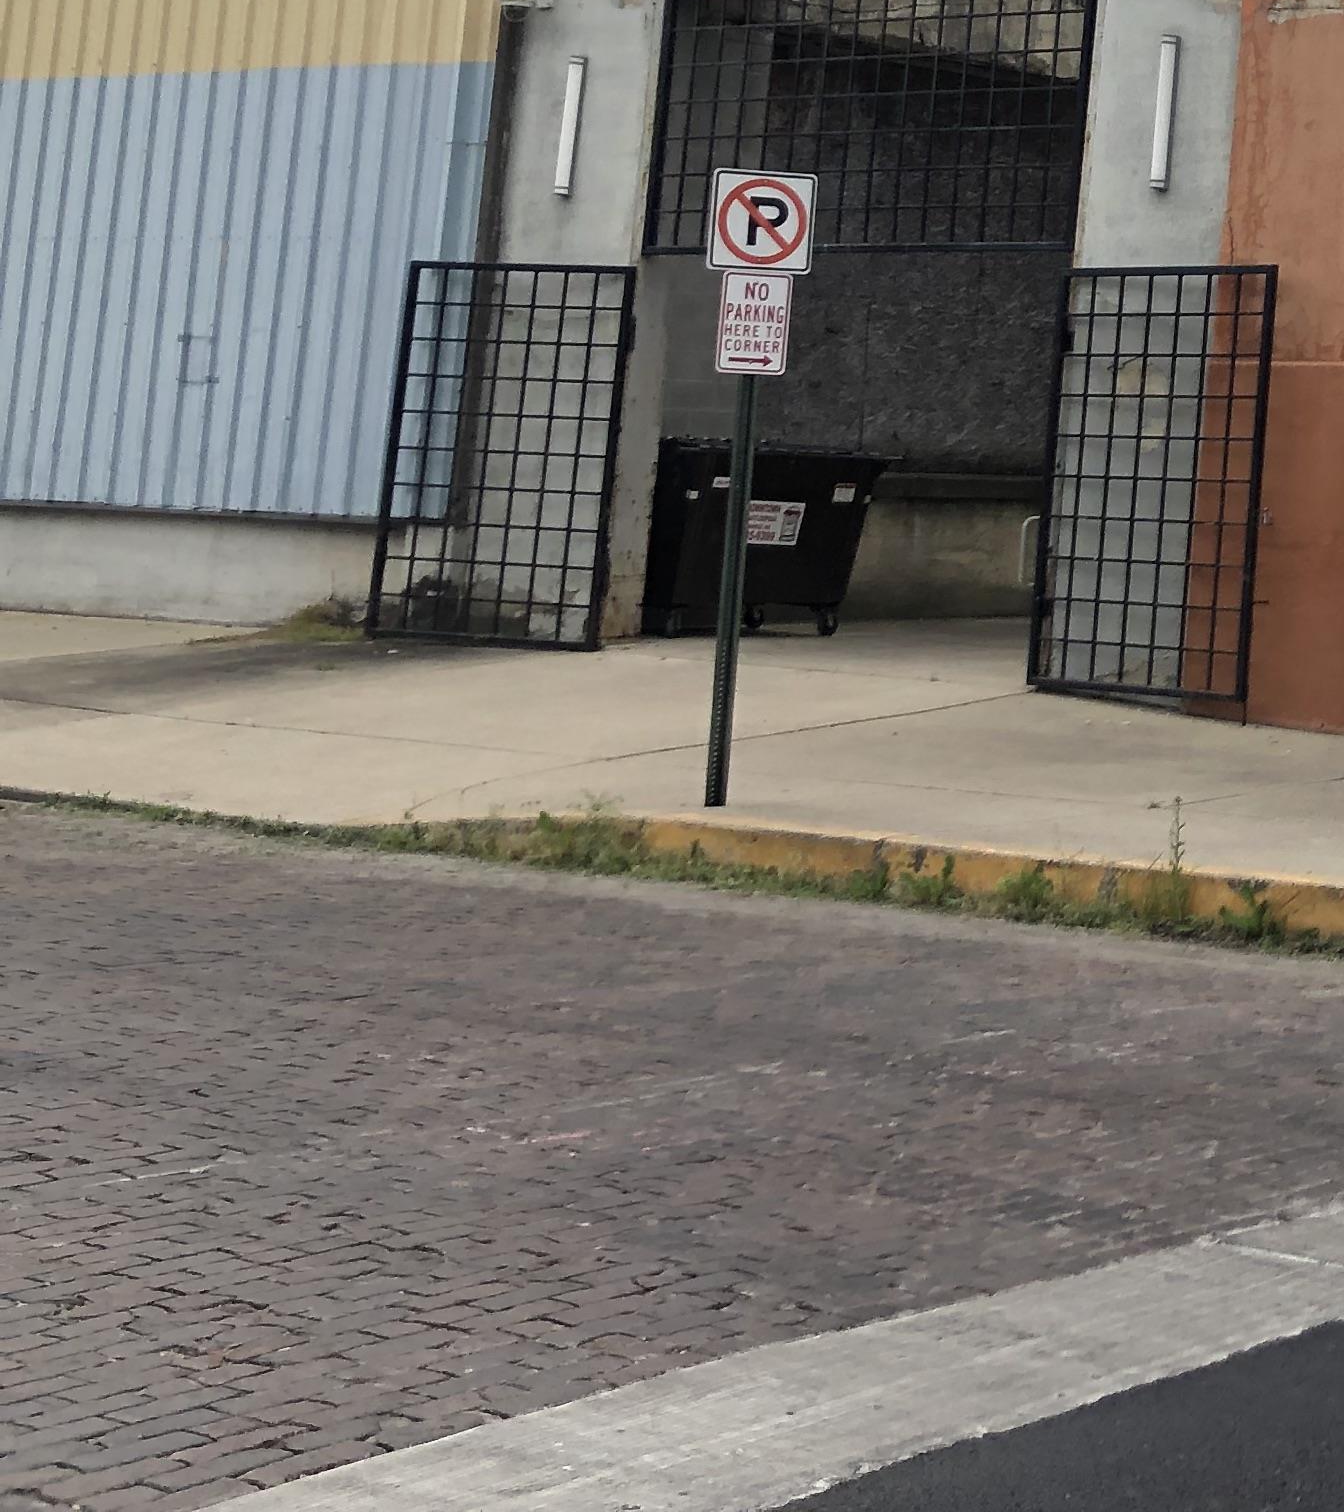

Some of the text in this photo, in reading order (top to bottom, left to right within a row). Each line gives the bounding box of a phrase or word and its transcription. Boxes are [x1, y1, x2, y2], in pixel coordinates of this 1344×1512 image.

[746, 196, 789, 246] P
[744, 282, 770, 302] NO
[726, 303, 784, 324] PARKING
[724, 322, 783, 339] HERE TO
[724, 338, 781, 354] CORNER
